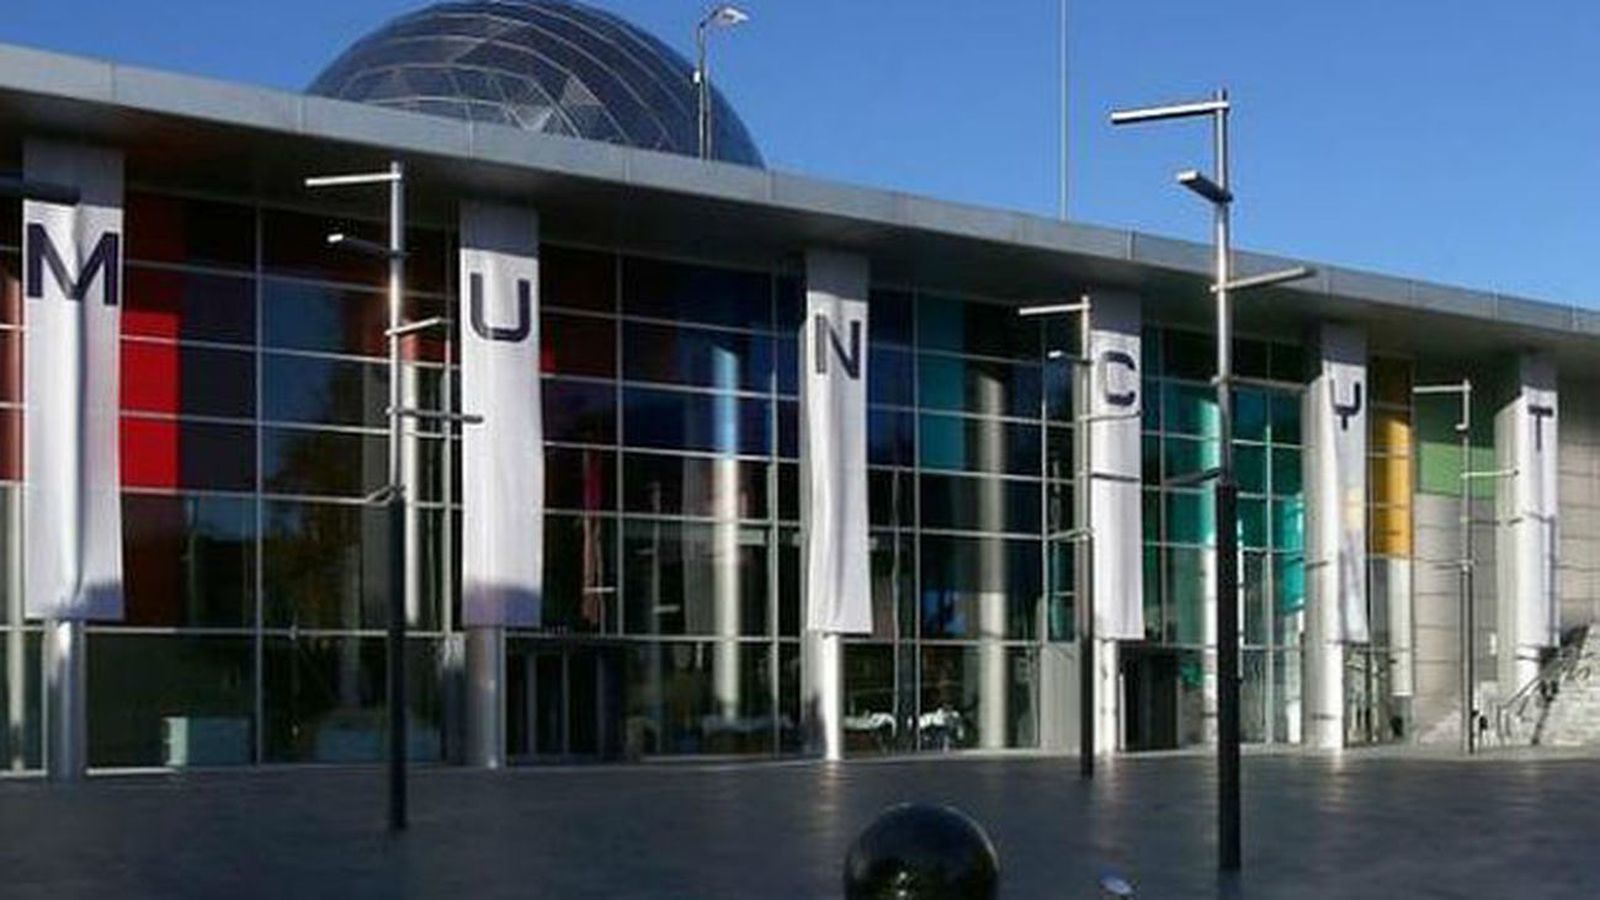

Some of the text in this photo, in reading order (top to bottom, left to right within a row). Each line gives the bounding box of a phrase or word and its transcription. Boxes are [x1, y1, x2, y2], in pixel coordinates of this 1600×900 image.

[27, 223, 118, 306] M
[469, 271, 532, 343] U
[815, 312, 860, 379] N
[1104, 350, 1136, 406] C
[1330, 379, 1361, 431] Y
[1528, 405, 1553, 452] T
